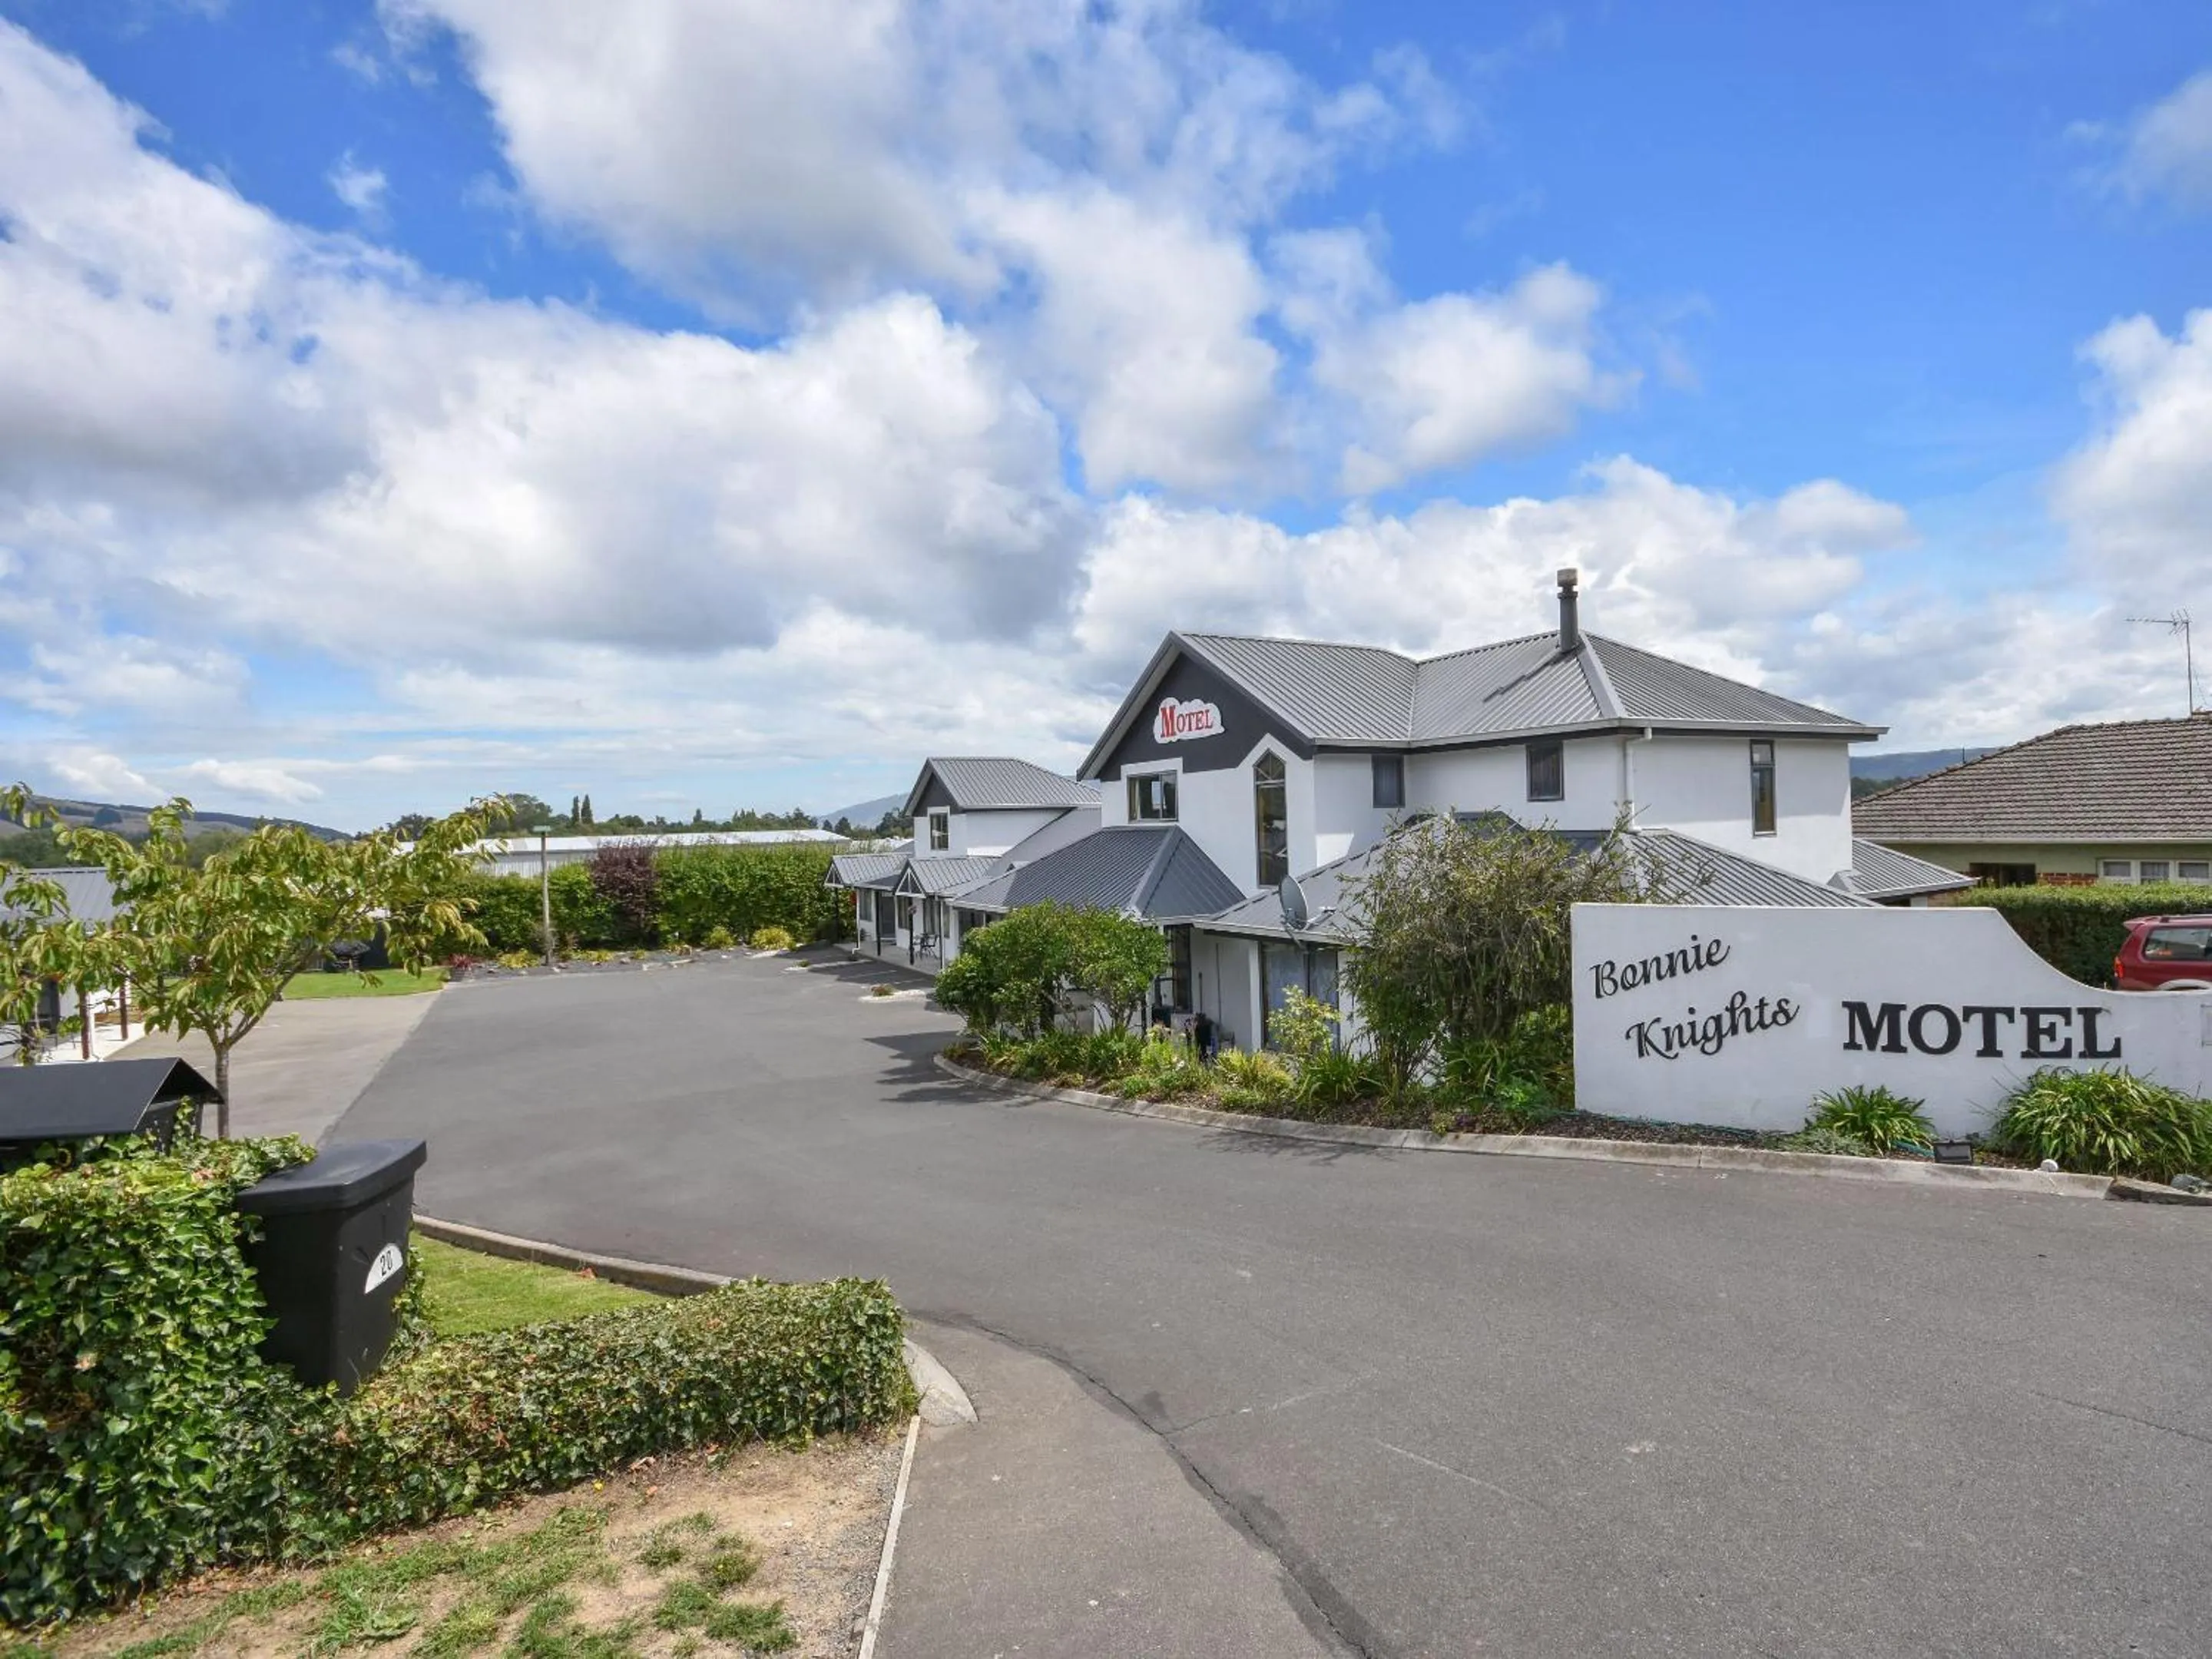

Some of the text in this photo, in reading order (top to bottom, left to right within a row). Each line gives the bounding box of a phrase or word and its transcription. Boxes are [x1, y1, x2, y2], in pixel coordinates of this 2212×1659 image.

[1160, 705, 1214, 738] MOTEL
[1590, 934, 1730, 999] Bonnie
[1625, 990, 1800, 1060] Knights
[1842, 1001, 2122, 1059] MOTEL
[379, 1250, 393, 1277] 20
